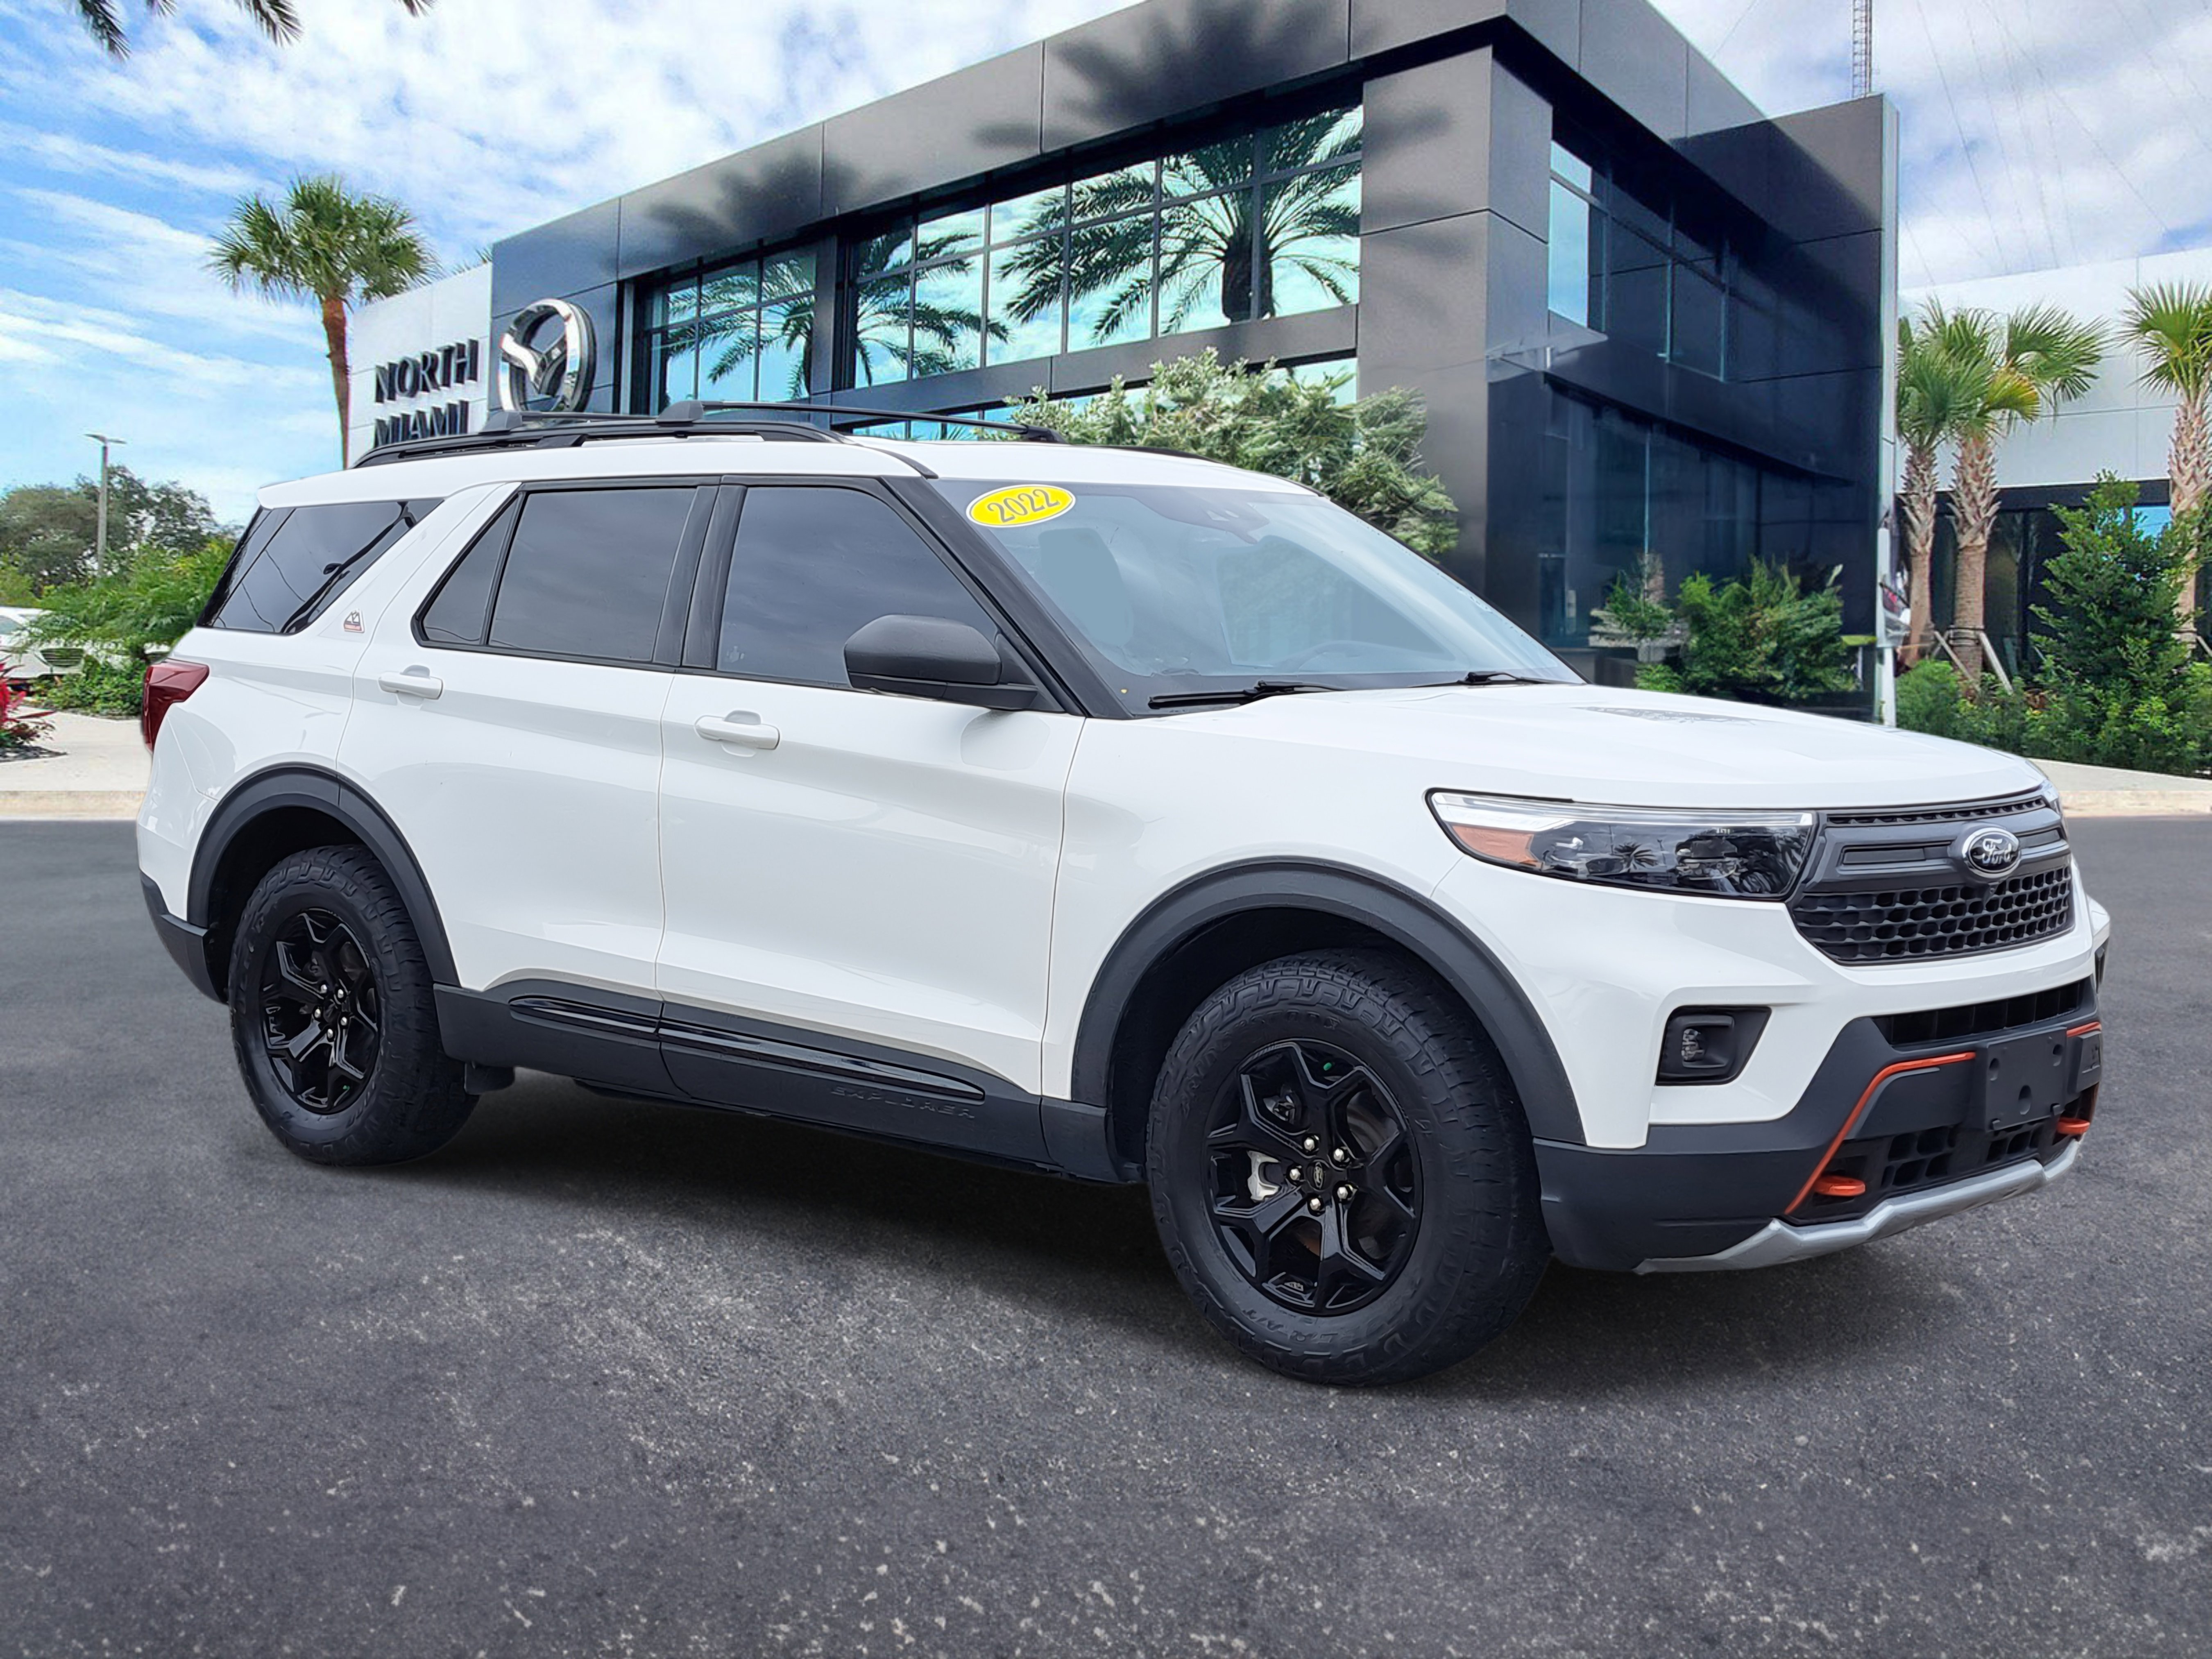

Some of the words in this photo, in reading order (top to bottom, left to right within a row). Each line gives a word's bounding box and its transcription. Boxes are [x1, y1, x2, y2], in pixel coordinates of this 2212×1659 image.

[374, 338, 479, 403] NORTH
[373, 400, 469, 449] MIAMI
[987, 489, 1061, 523] 2022
[1972, 838, 2012, 864] Ford
